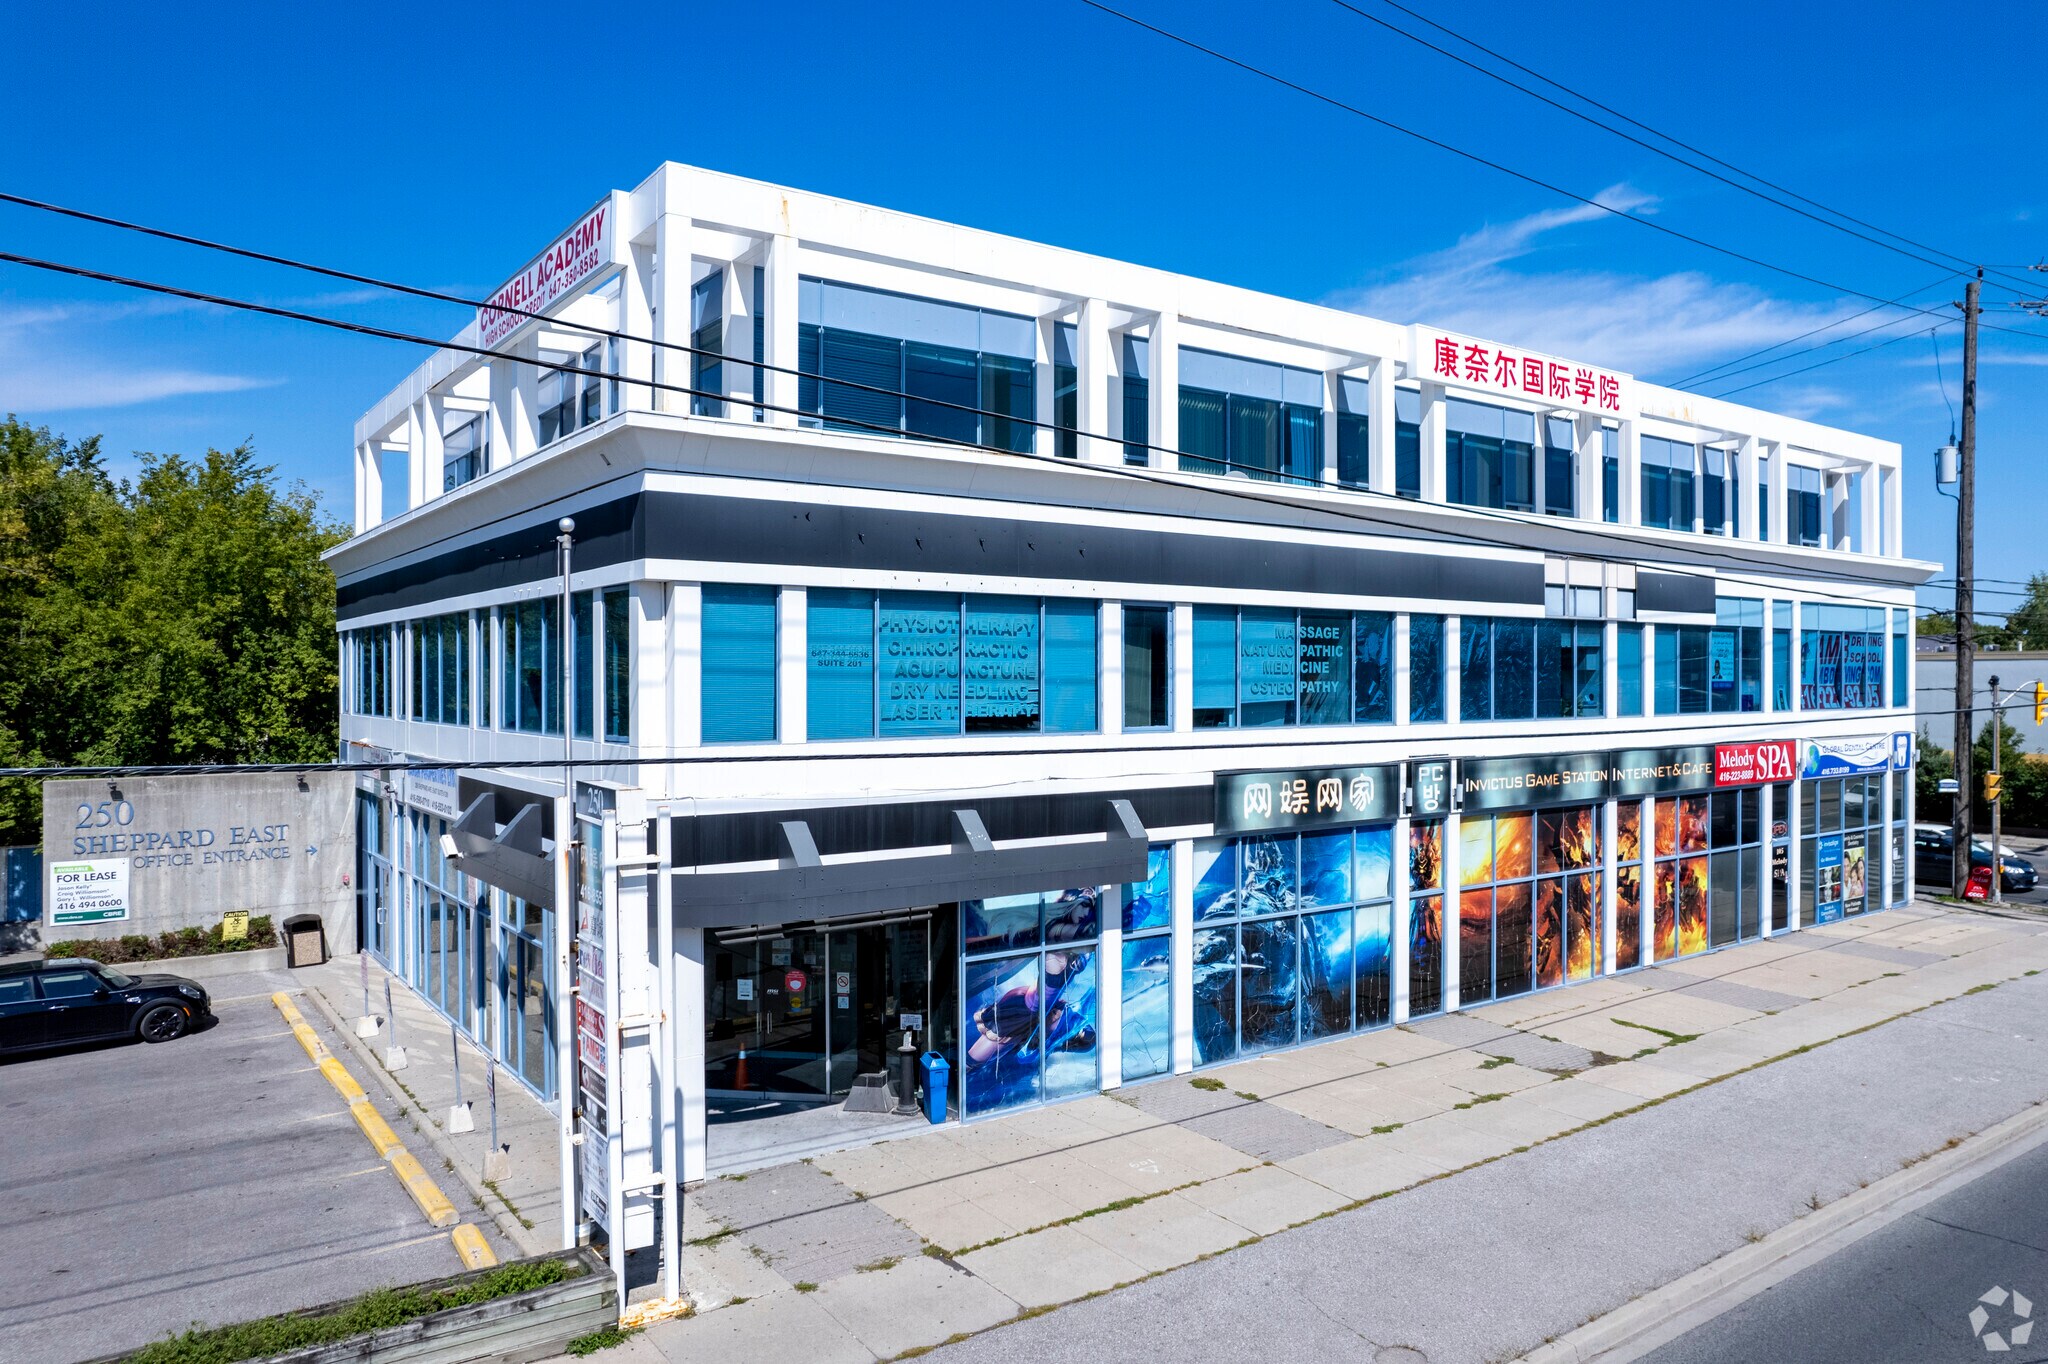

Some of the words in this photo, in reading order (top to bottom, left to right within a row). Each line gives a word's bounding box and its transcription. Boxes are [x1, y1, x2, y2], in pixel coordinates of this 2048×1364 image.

[480, 271, 534, 332] CORNELL
[536, 208, 606, 291] ACADEMY
[485, 319, 499, 349] HIGH
[524, 290, 546, 319] CREDIT
[548, 247, 599, 300] 647-350-8582
[1434, 336, 1620, 411] 康奈尔国际学院
[879, 613, 1035, 637] PHYSIOTHERAPY
[1275, 626, 1340, 640] MASSAGE
[888, 641, 1029, 659] CHIROPRACTIC
[1241, 644, 1344, 658] NATUROPATHIC
[894, 660, 1036, 681] ACUPUNCTURE
[1262, 661, 1330, 675] MEDICINE
[890, 682, 929, 700] DRY
[934, 682, 1029, 702] NEEDLING
[1250, 681, 1339, 696] OSTEOPATHY
[880, 703, 942, 722] LASER
[946, 702, 1035, 721] THERAPY
[1719, 748, 1755, 769] Melody
[1756, 744, 1793, 780] SPA
[1418, 766, 1444, 783] PC
[1465, 776, 1523, 793] INVICTUS
[1525, 773, 1560, 788] GAME
[1562, 769, 1608, 784] STATION
[587, 787, 604, 815] 250
[1244, 773, 1375, 820] 网娱网家
[1422, 784, 1441, 811] 방
[75, 800, 135, 830] 250
[73, 829, 215, 856] SHEPPARD
[229, 824, 290, 846] EAST
[133, 853, 194, 869] OFFICE
[203, 846, 291, 865] ENTRANCE
[56, 874, 80, 883] FOR
[84, 871, 117, 881] LEASE
[57, 902, 76, 910] 416
[78, 901, 96, 909] 494
[98, 898, 122, 907] 0600
